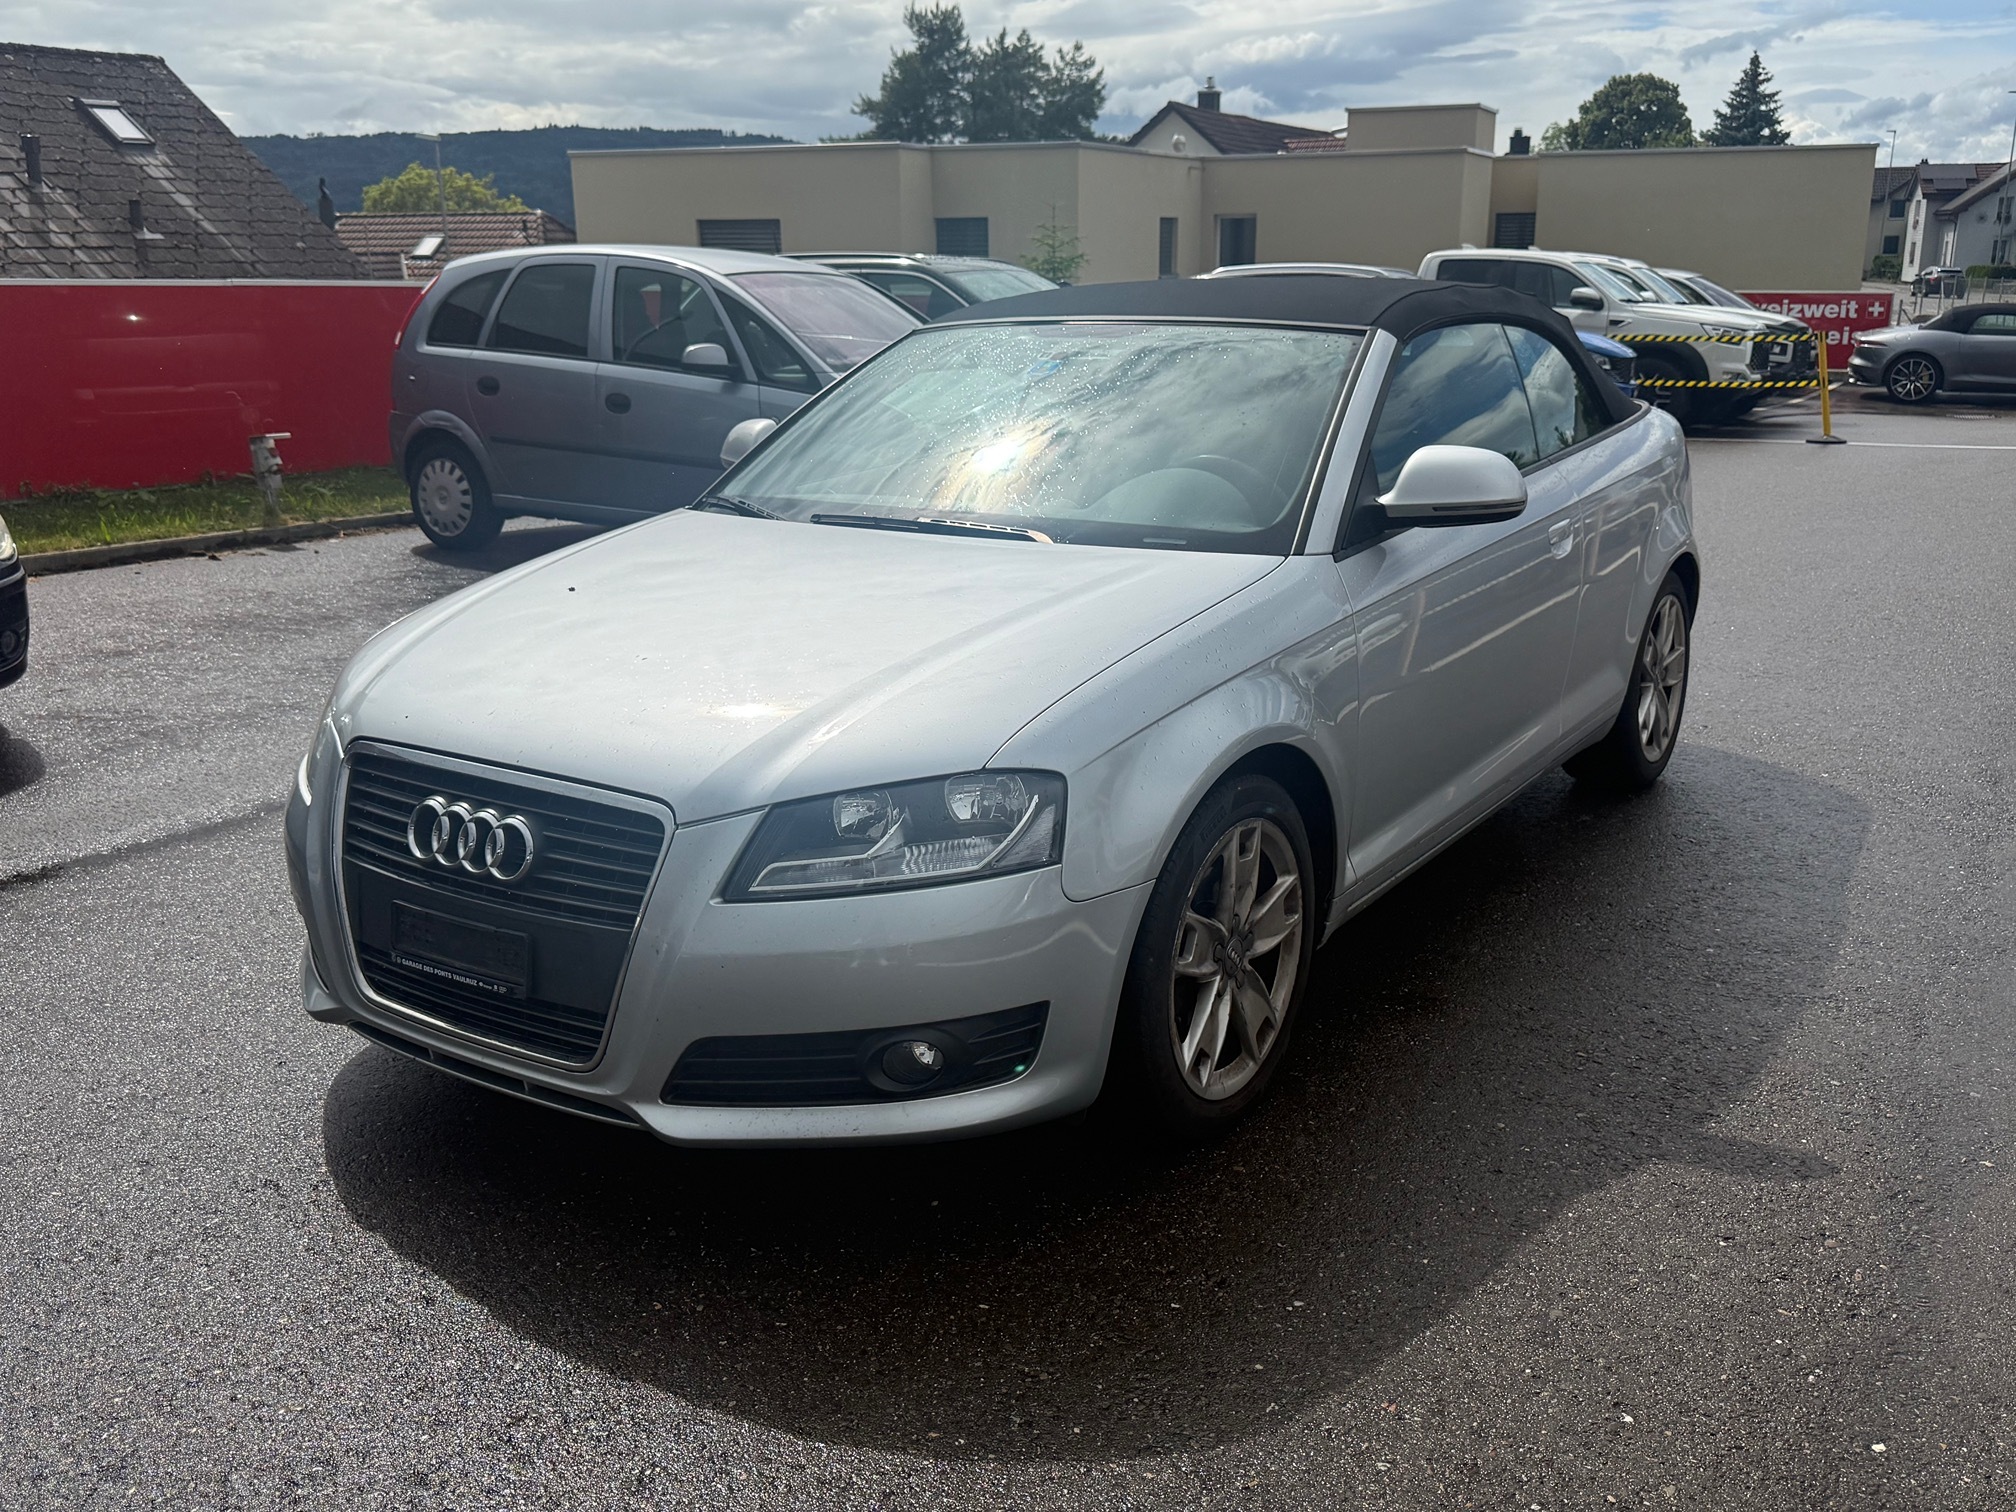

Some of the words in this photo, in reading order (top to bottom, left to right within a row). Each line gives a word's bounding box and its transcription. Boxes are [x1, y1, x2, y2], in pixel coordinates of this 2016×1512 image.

[402, 959, 423, 969] GARAGE
[423, 964, 433, 973] DES
[434, 968, 452, 979] PONTS
[452, 973, 478, 986] VAULRUZ
